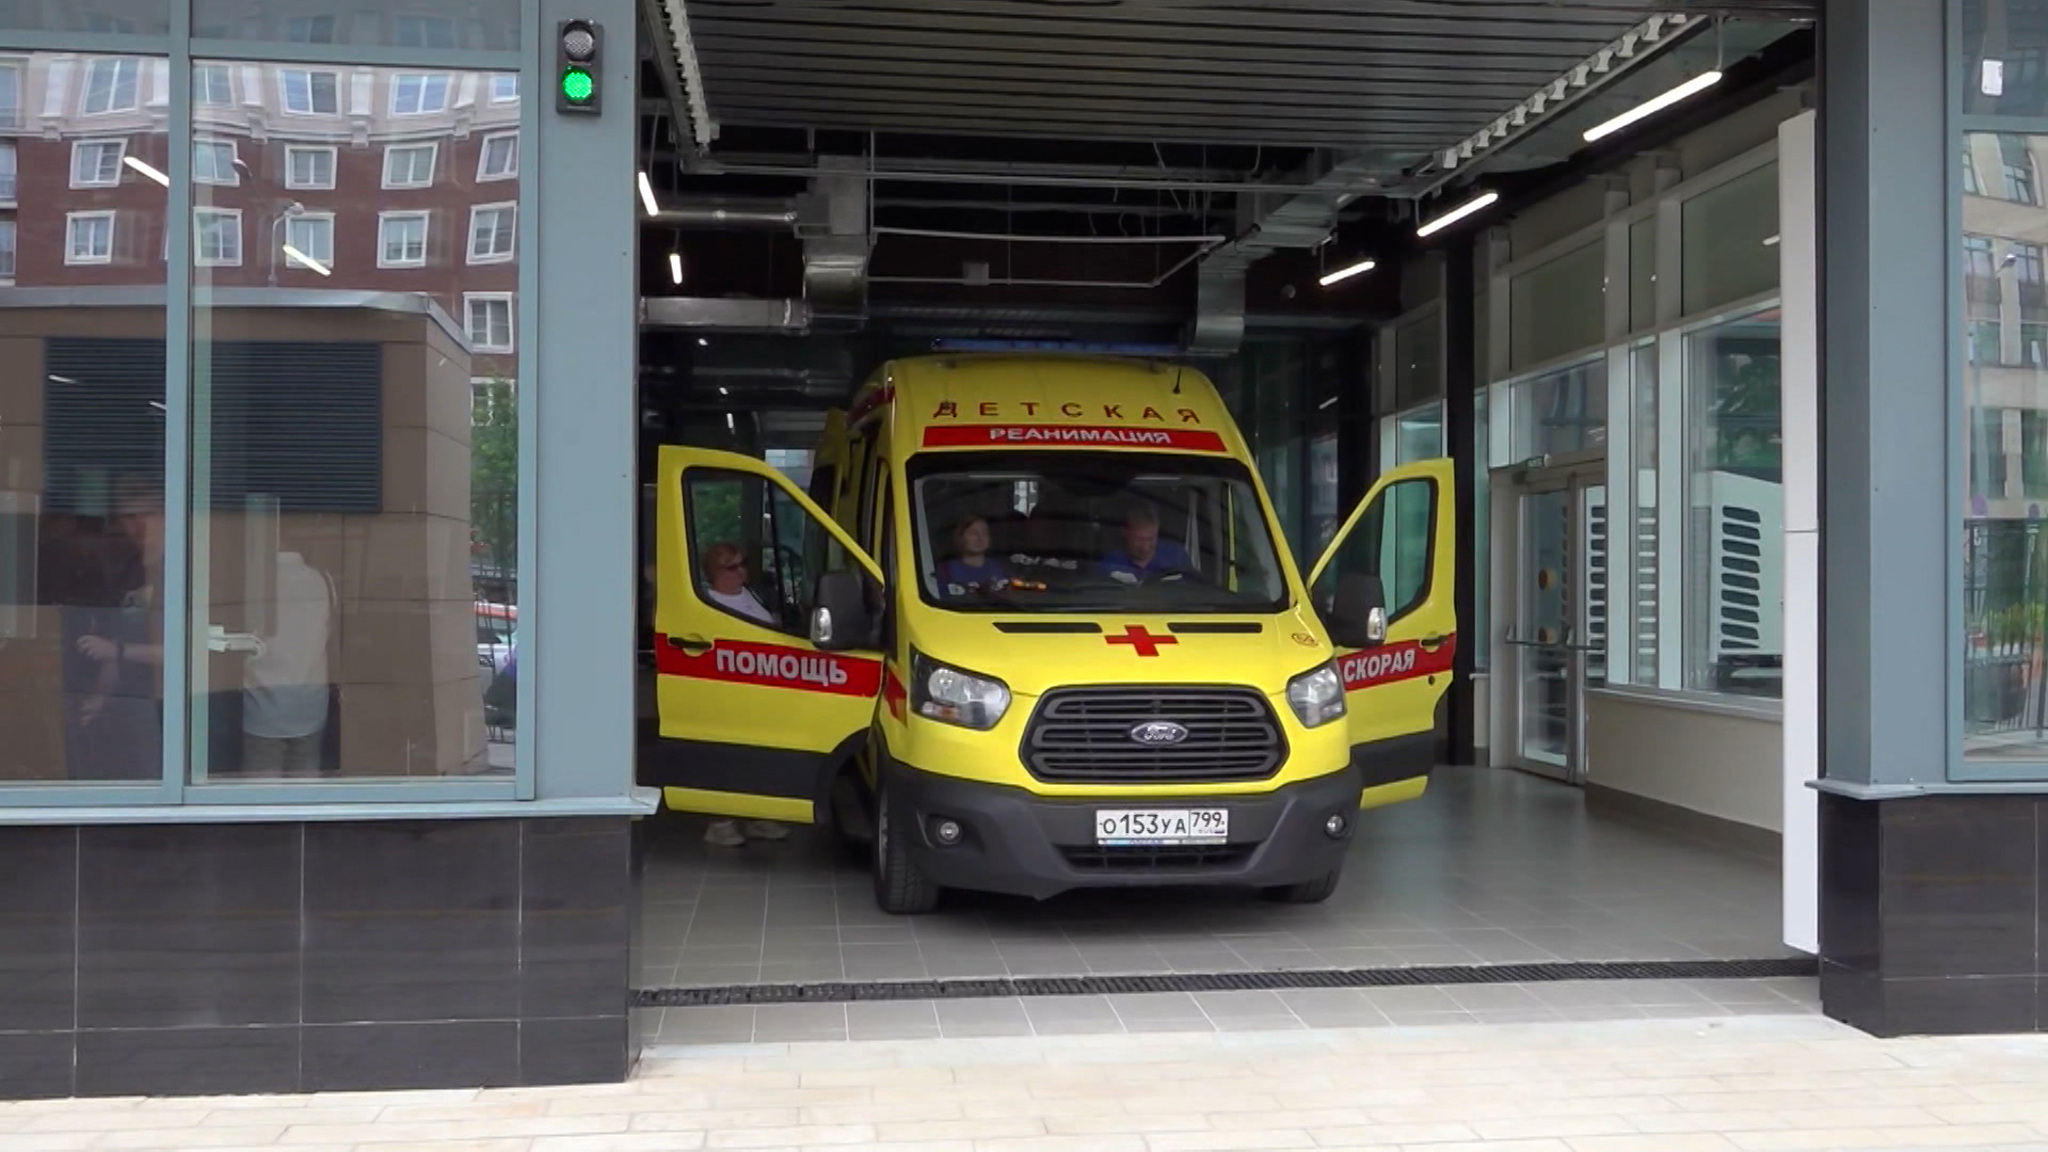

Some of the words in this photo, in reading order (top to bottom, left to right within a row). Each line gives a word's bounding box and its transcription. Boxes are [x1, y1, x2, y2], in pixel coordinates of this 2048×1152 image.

[933, 402, 1201, 424] ДЕТСКАЯ
[990, 428, 1171, 443] РЕАНИМАЦИЯ
[716, 649, 848, 686] ПОМОЩЬ
[1343, 649, 1416, 683] СКОРАЯ
[1143, 726, 1177, 740] Ford
[1191, 812, 1222, 828] 799
